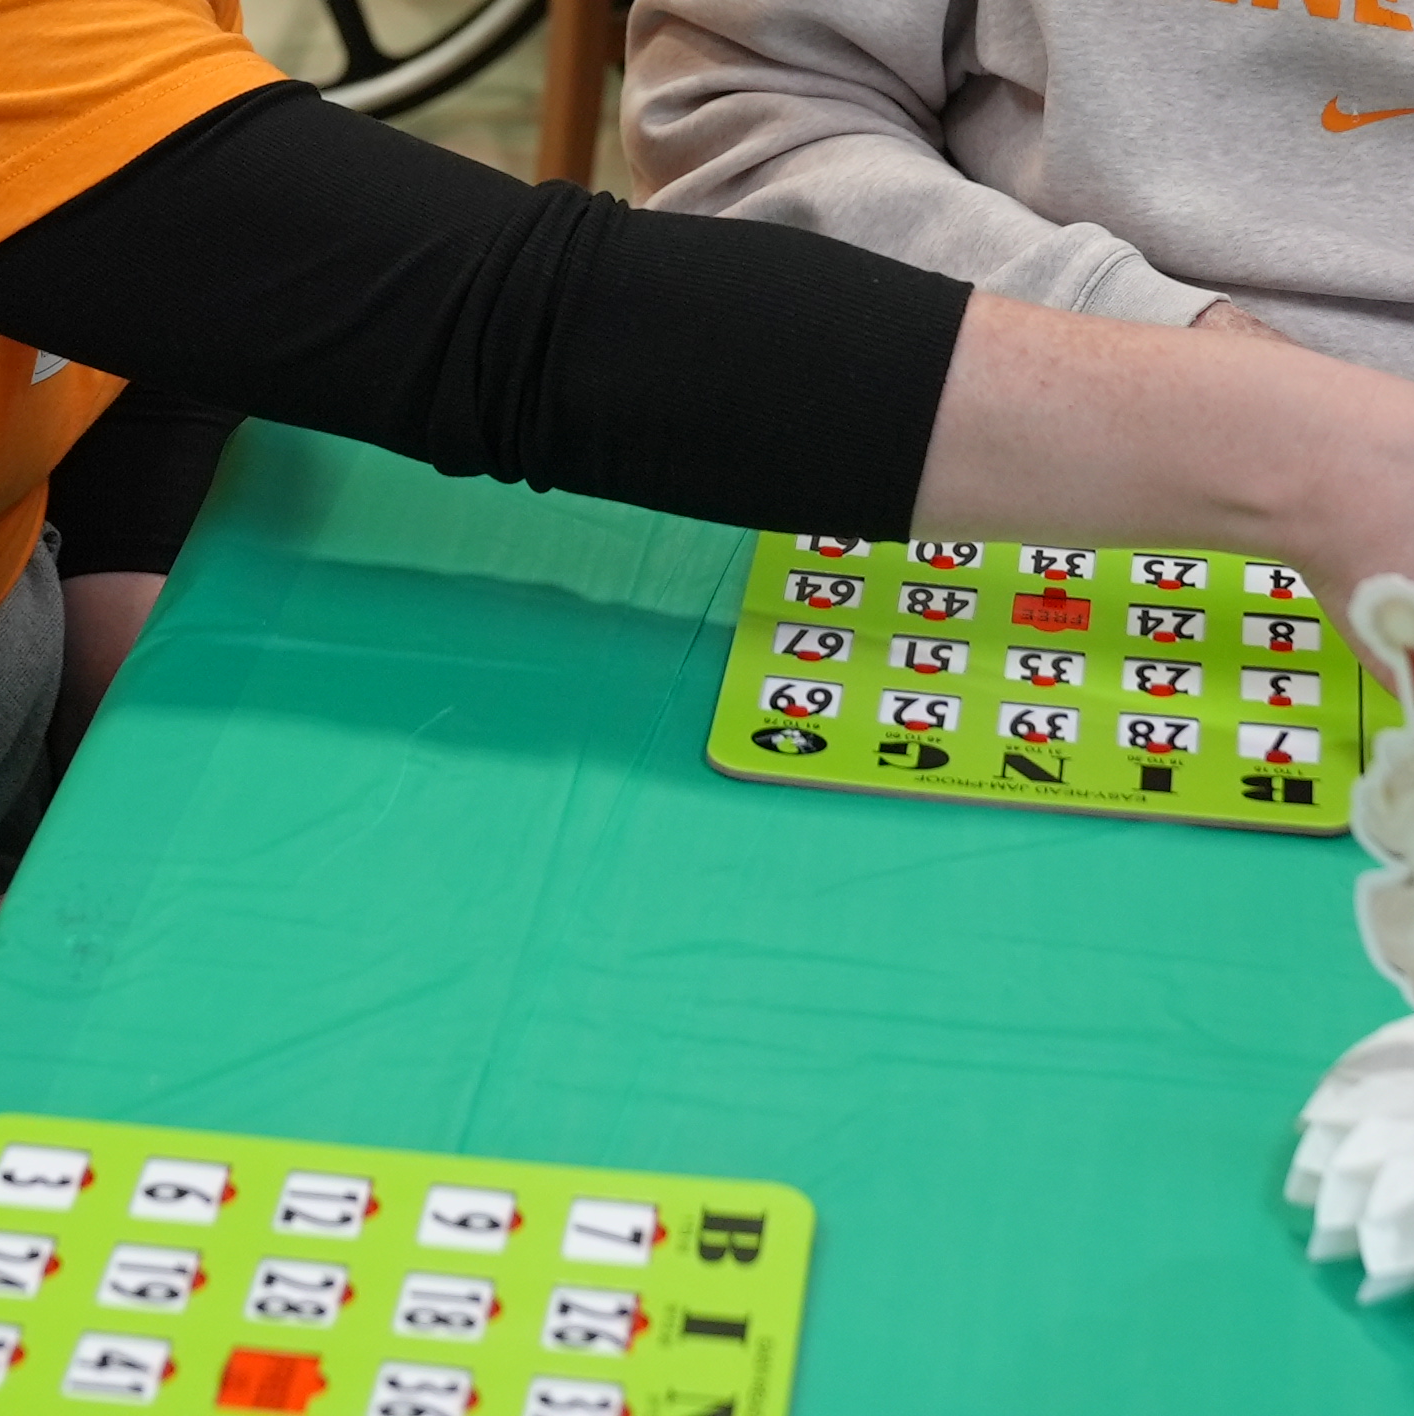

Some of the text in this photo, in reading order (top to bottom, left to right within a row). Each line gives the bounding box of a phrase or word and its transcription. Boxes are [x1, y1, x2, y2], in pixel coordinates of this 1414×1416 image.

[916, 541, 978, 566] 60
[1031, 549, 1086, 578] 34
[1143, 560, 1198, 588] 25
[1270, 569, 1296, 591] 4
[795, 576, 856, 606] 64
[907, 589, 969, 618] 48
[1137, 610, 1197, 640] 24
[1269, 621, 1295, 645] 8
[782, 629, 1292, 699] 3 23 35 51 67
[769, 684, 833, 716] 69
[893, 696, 949, 727] 52
[1010, 709, 1070, 741] 39
[1128, 719, 1190, 751] 28
[2, 1168, 71, 1188] 3
[282, 1190, 358, 1228] 12
[432, 1211, 501, 1233] 9
[574, 1224, 642, 1246] 7
[71, 1182, 213, 1395] 6 19 41
[255, 1272, 335, 1317] 28
[404, 1289, 482, 1331] 18
[555, 1302, 629, 1350] 26
